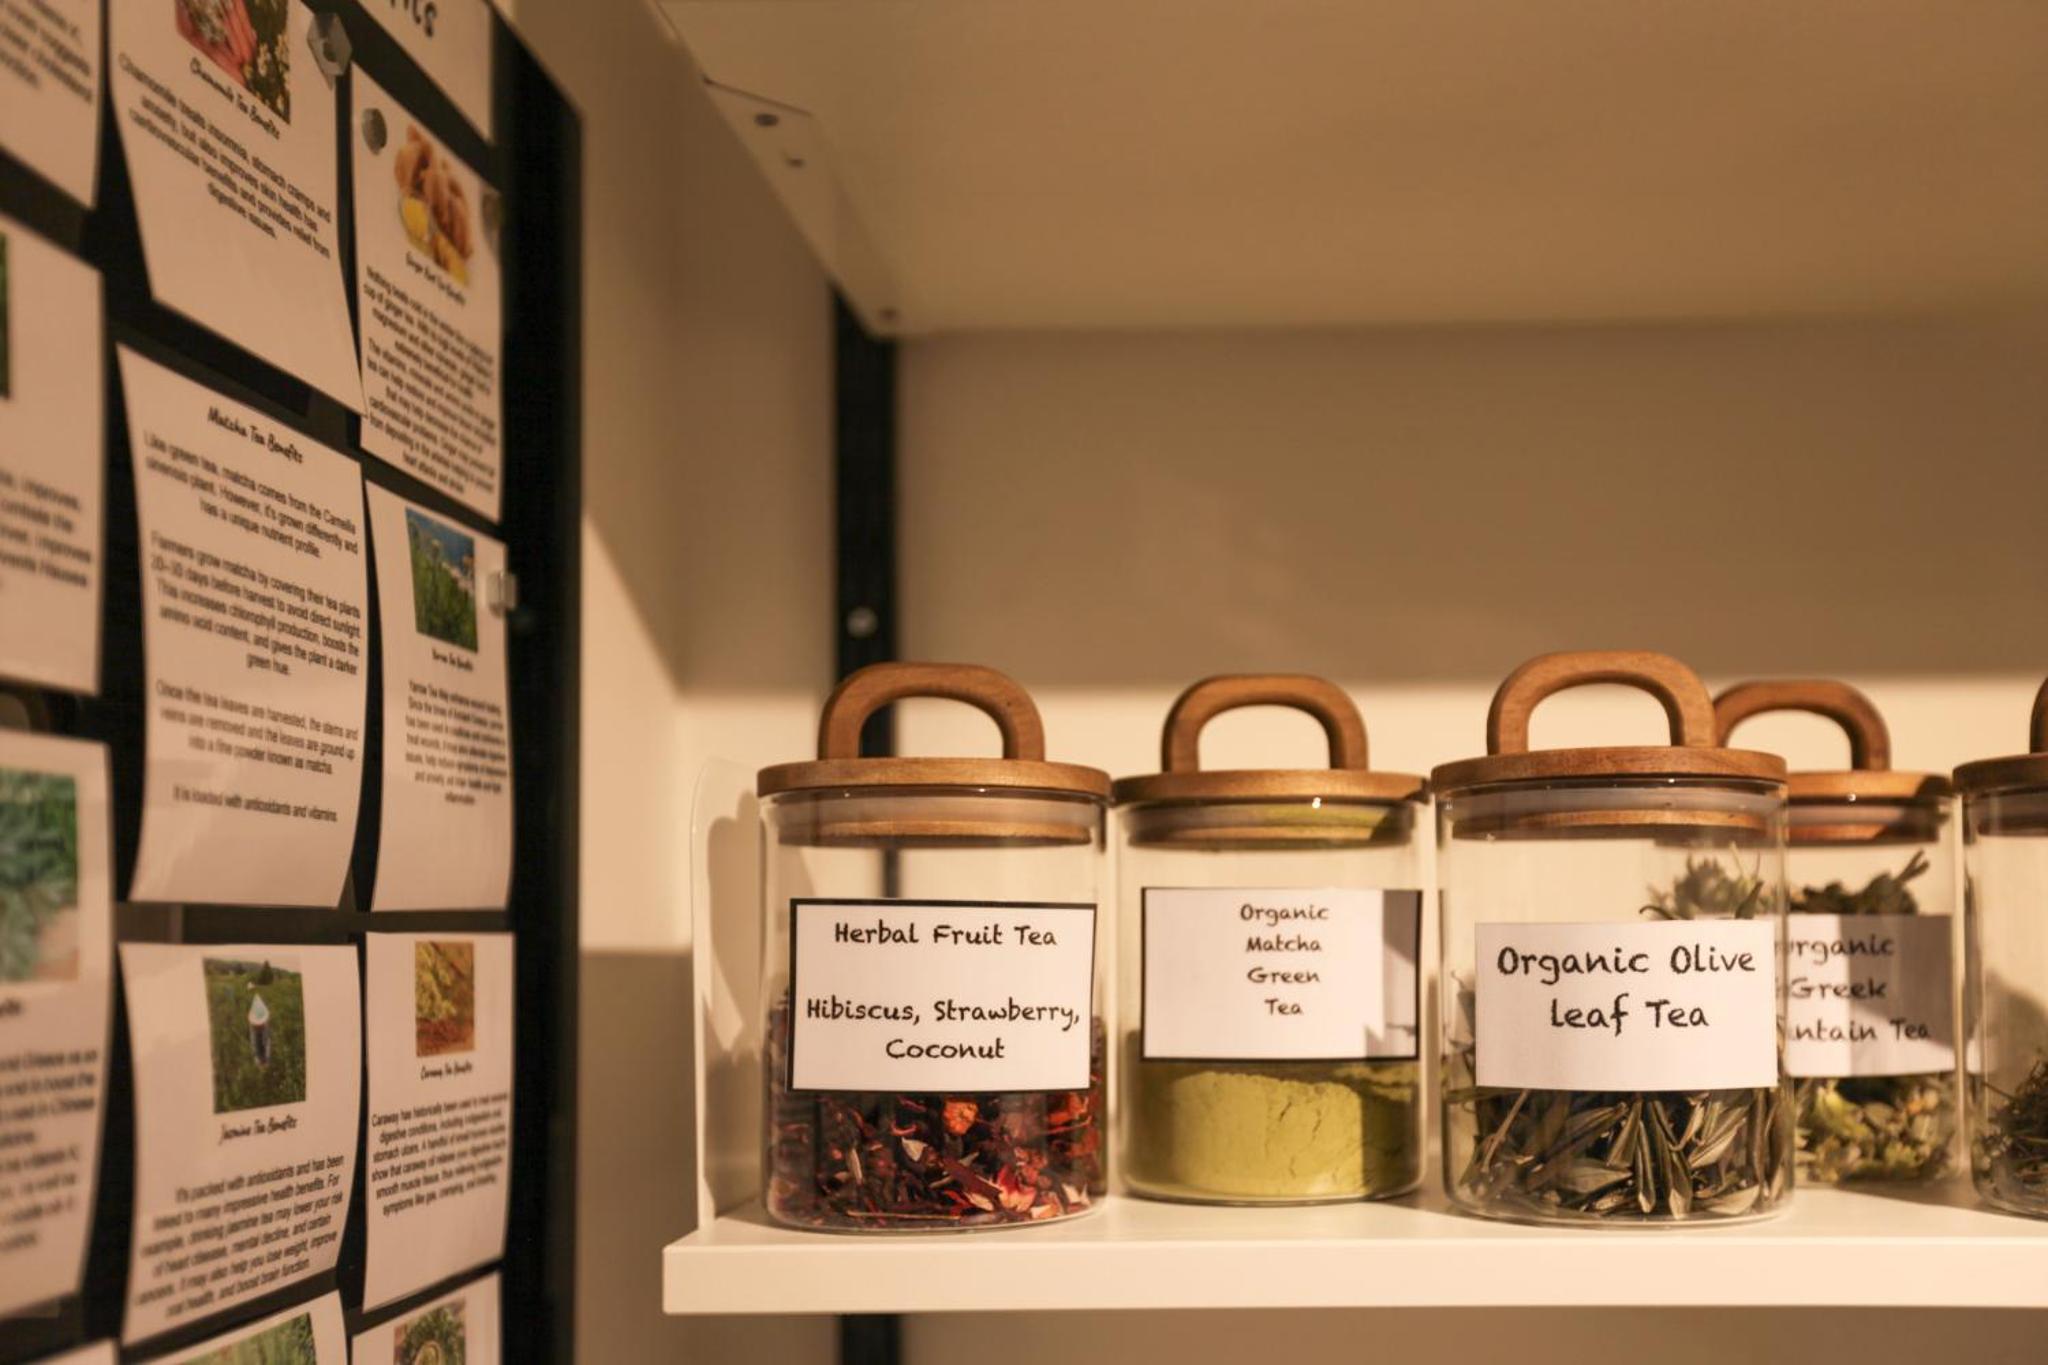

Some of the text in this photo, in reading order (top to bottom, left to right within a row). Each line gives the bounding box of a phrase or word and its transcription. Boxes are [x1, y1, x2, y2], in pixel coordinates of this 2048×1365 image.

[208, 408, 303, 463] Matcha Tea Benefits
[1240, 904, 1329, 927] Organic
[835, 920, 1057, 946] Herbal Fruit Tea
[1246, 934, 1322, 952] Matcha
[1790, 934, 1894, 965] rganic
[1247, 967, 1321, 984] Green
[1497, 944, 1756, 986] Organic Olive
[1790, 977, 1887, 999] Greek
[807, 995, 1081, 1032] Hibiscus, Strawberry,
[1264, 999, 1303, 1015] Tea
[1645, 999, 1710, 1028] Tea
[1889, 1018, 1929, 1040] Tea
[885, 1038, 1005, 1059] Coconut
